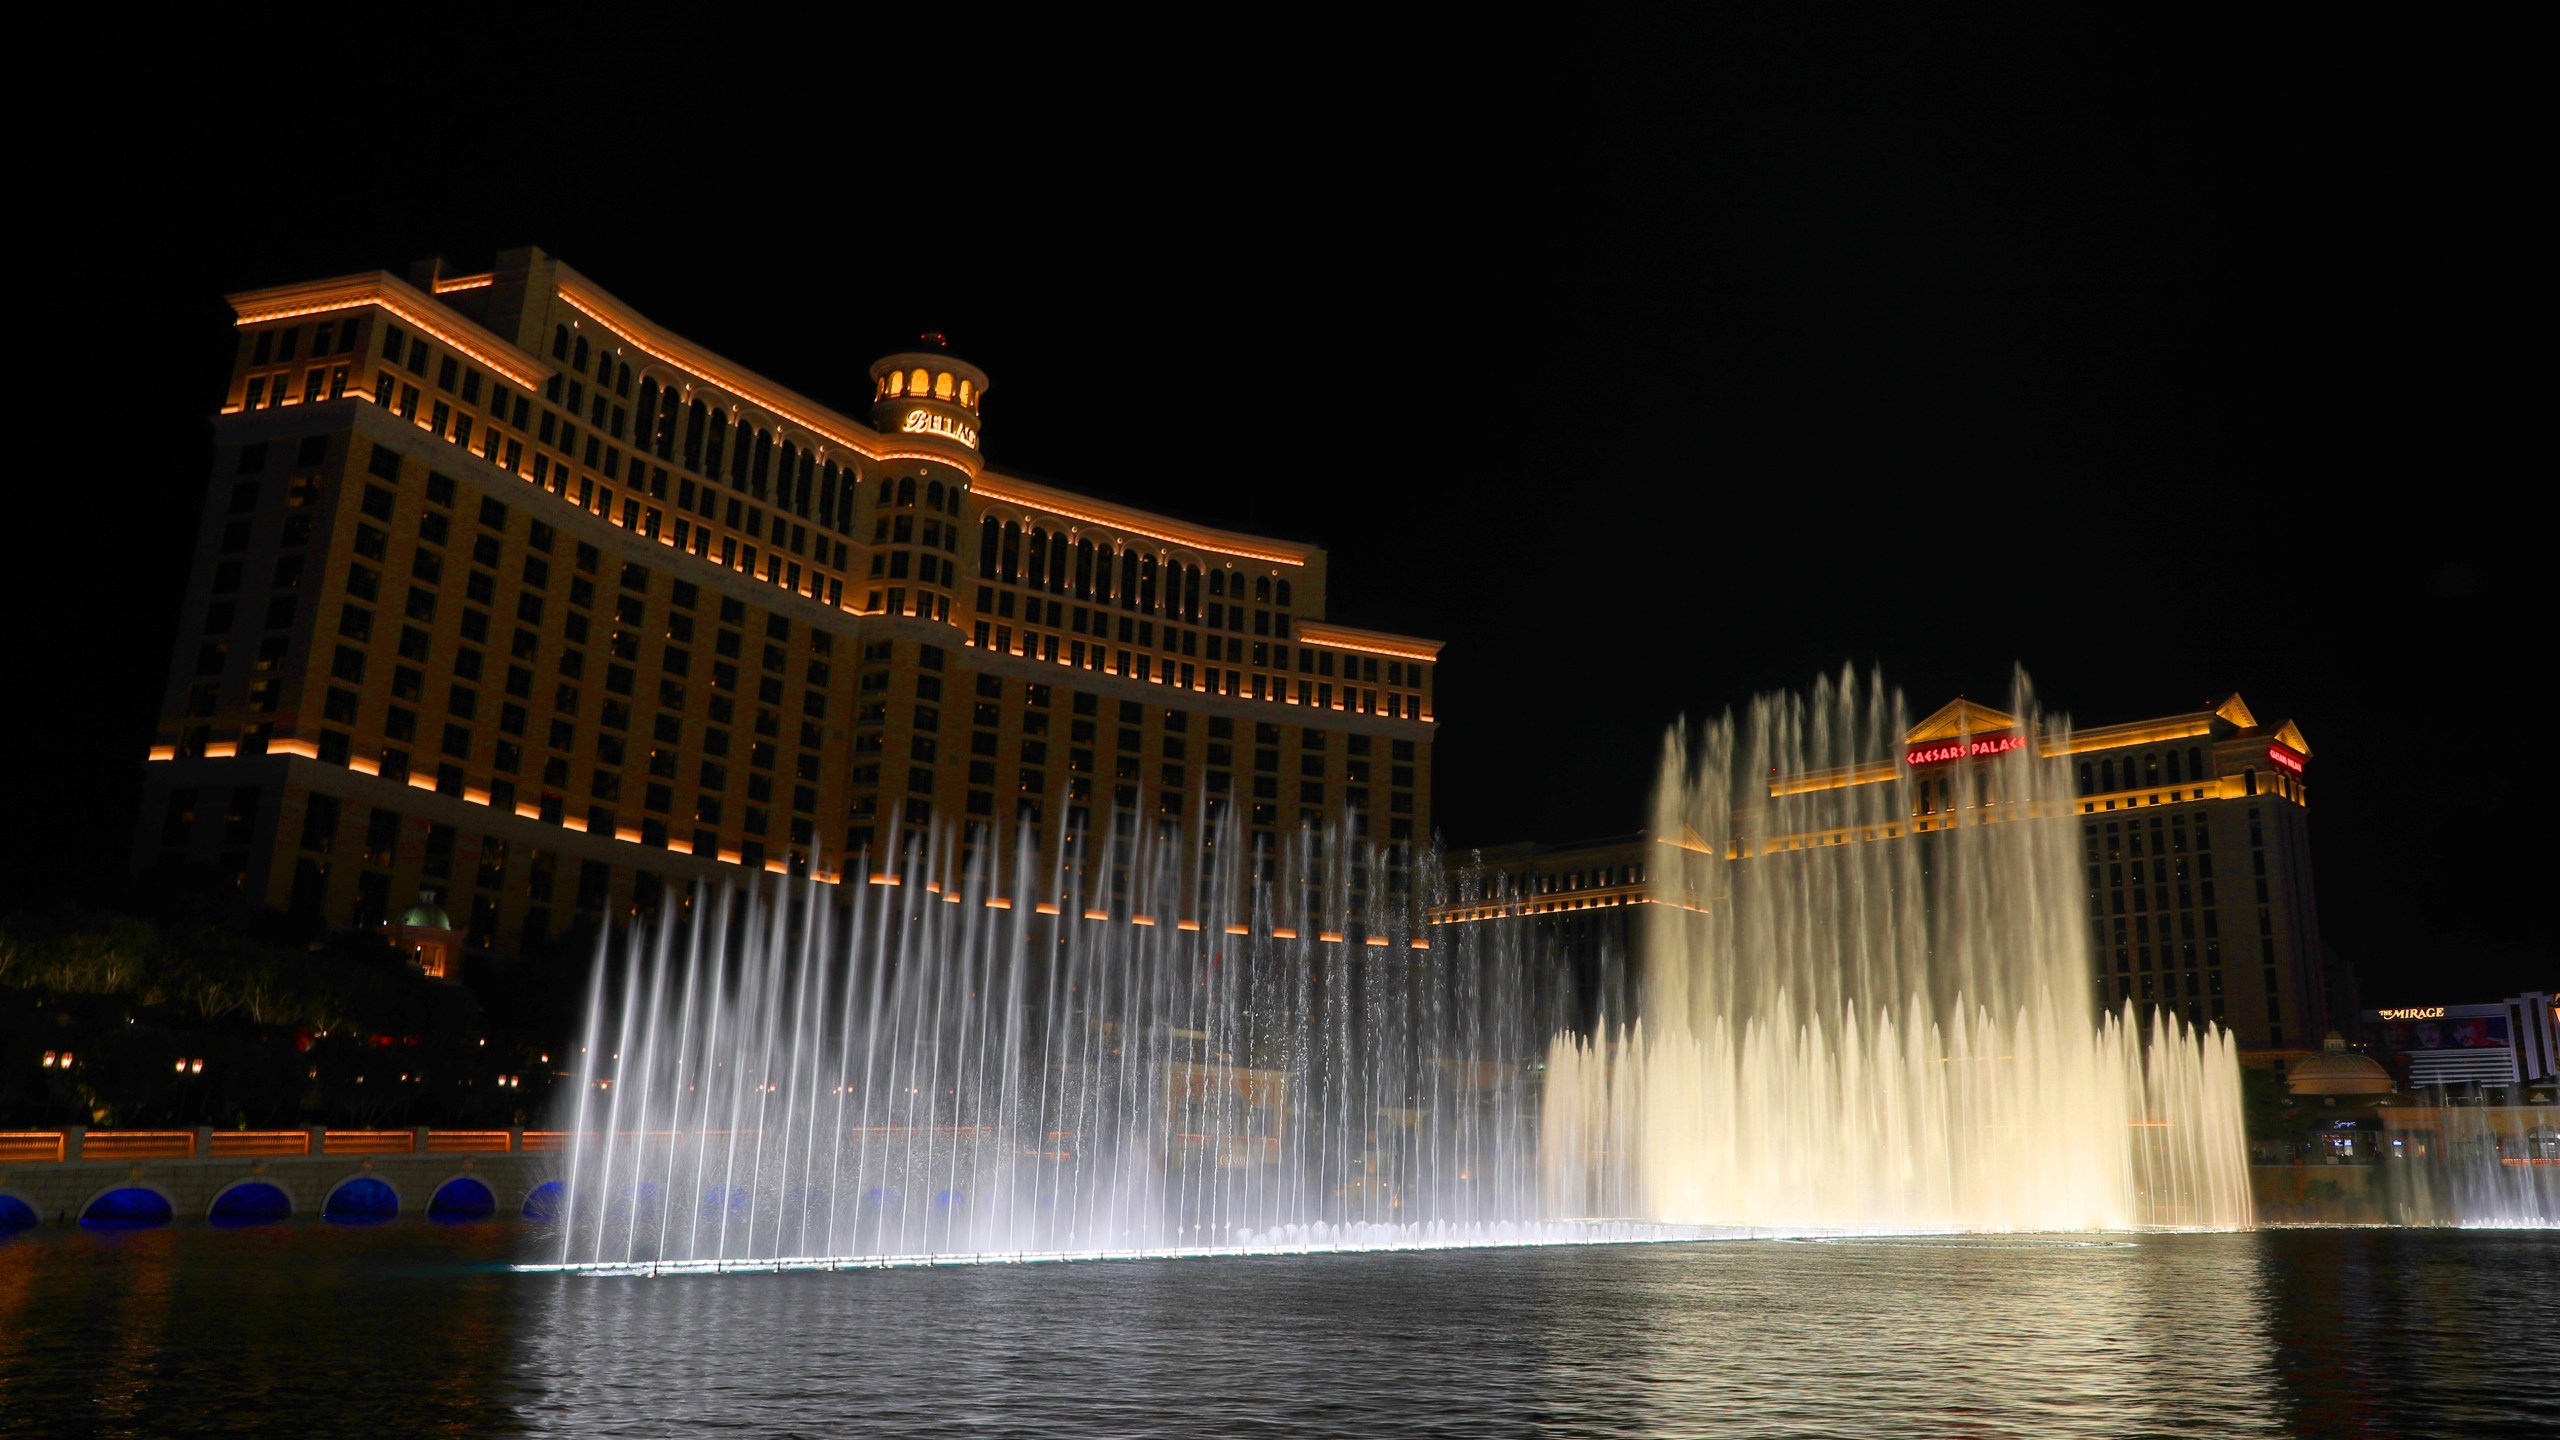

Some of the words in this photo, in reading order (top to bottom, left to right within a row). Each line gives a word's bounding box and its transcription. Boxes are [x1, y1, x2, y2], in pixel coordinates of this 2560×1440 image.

[1906, 745, 1967, 765] CAESARS
[1971, 736, 2027, 755] PALACE
[2384, 1007, 2445, 1020] MIRAGE
